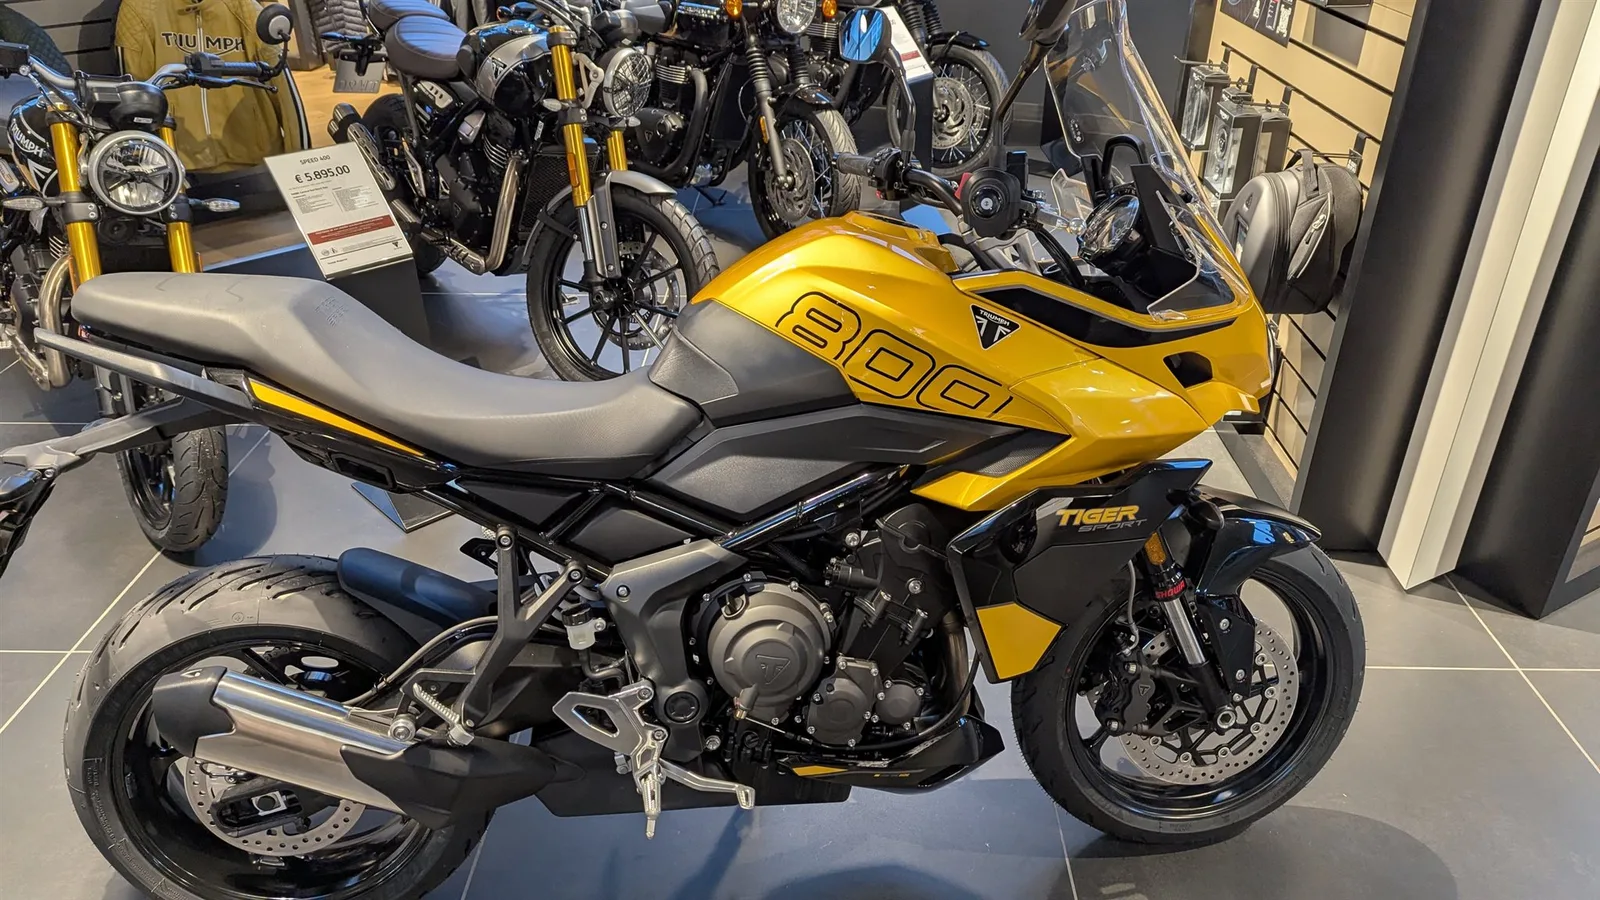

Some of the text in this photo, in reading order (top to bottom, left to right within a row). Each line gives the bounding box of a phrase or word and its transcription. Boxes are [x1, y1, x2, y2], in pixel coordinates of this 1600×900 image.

[300, 154, 331, 165] SPEED 400
[304, 164, 351, 182] 5.895,00
[980, 309, 1010, 327] TRIUMPH
[775, 291, 1014, 418] 800
[1055, 505, 1140, 527] TIGER
[1078, 519, 1148, 533] SPORT
[1155, 580, 1186, 599] SHOWA
